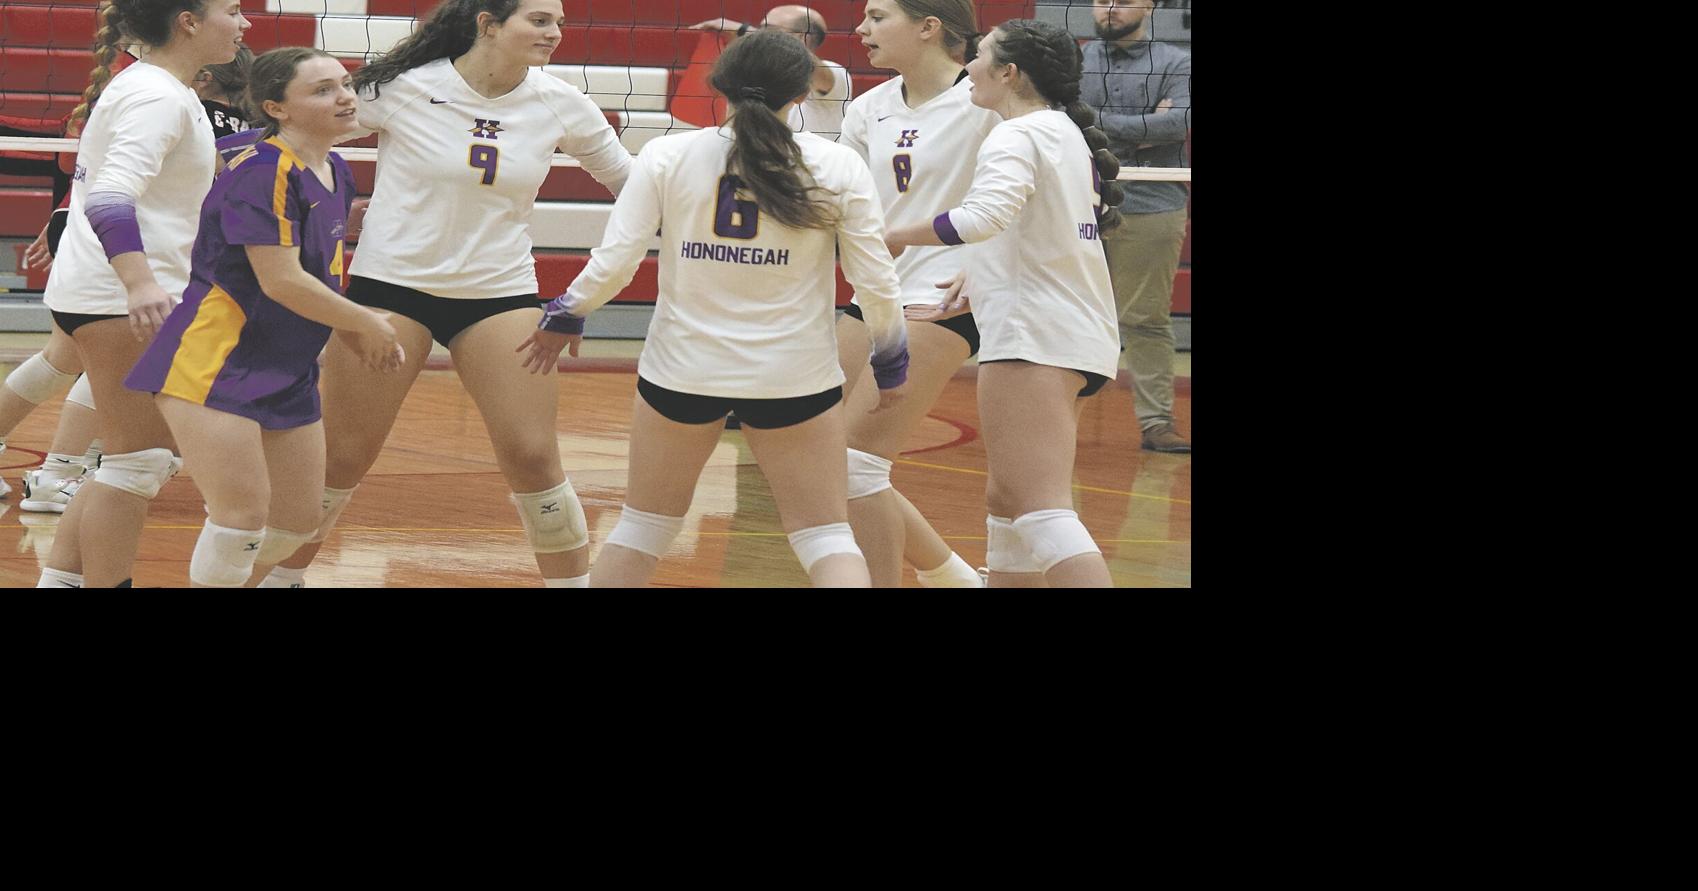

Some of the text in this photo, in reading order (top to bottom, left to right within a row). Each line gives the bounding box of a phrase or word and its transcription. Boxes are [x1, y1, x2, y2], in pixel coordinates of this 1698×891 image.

[468, 118, 503, 140] H
[467, 143, 499, 187] 9
[892, 151, 912, 195] 8
[712, 173, 760, 241] 6
[681, 240, 790, 266] HONONEGAH
